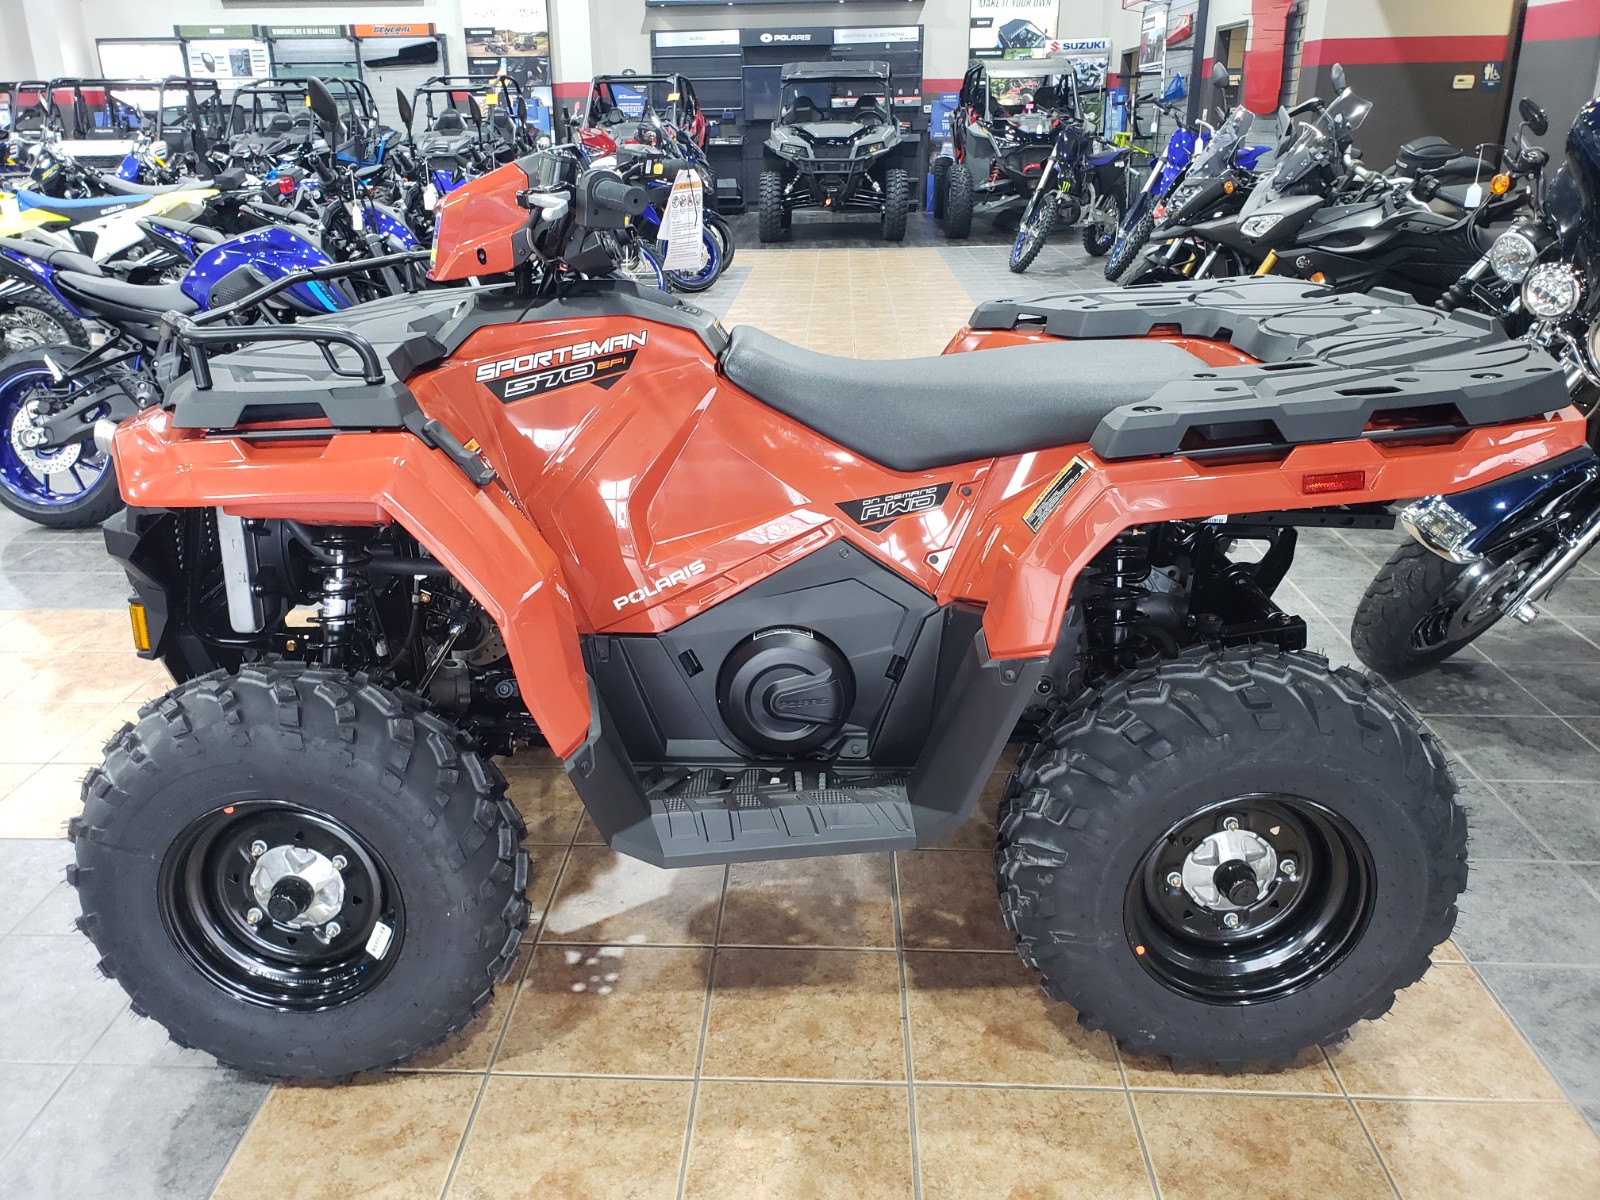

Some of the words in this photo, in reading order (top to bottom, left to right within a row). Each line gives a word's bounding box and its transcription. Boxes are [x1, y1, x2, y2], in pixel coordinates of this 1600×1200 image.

[1062, 41, 1106, 50] SUZUKI
[100, 203, 127, 215] SUZUKI
[475, 329, 648, 383] SPORTSMAN
[504, 361, 595, 398] 570
[596, 356, 627, 371] EFI
[860, 494, 936, 521] AWD
[862, 498, 880, 506] ON
[885, 487, 937, 502] DEMAND
[612, 559, 706, 611] POLARIS
